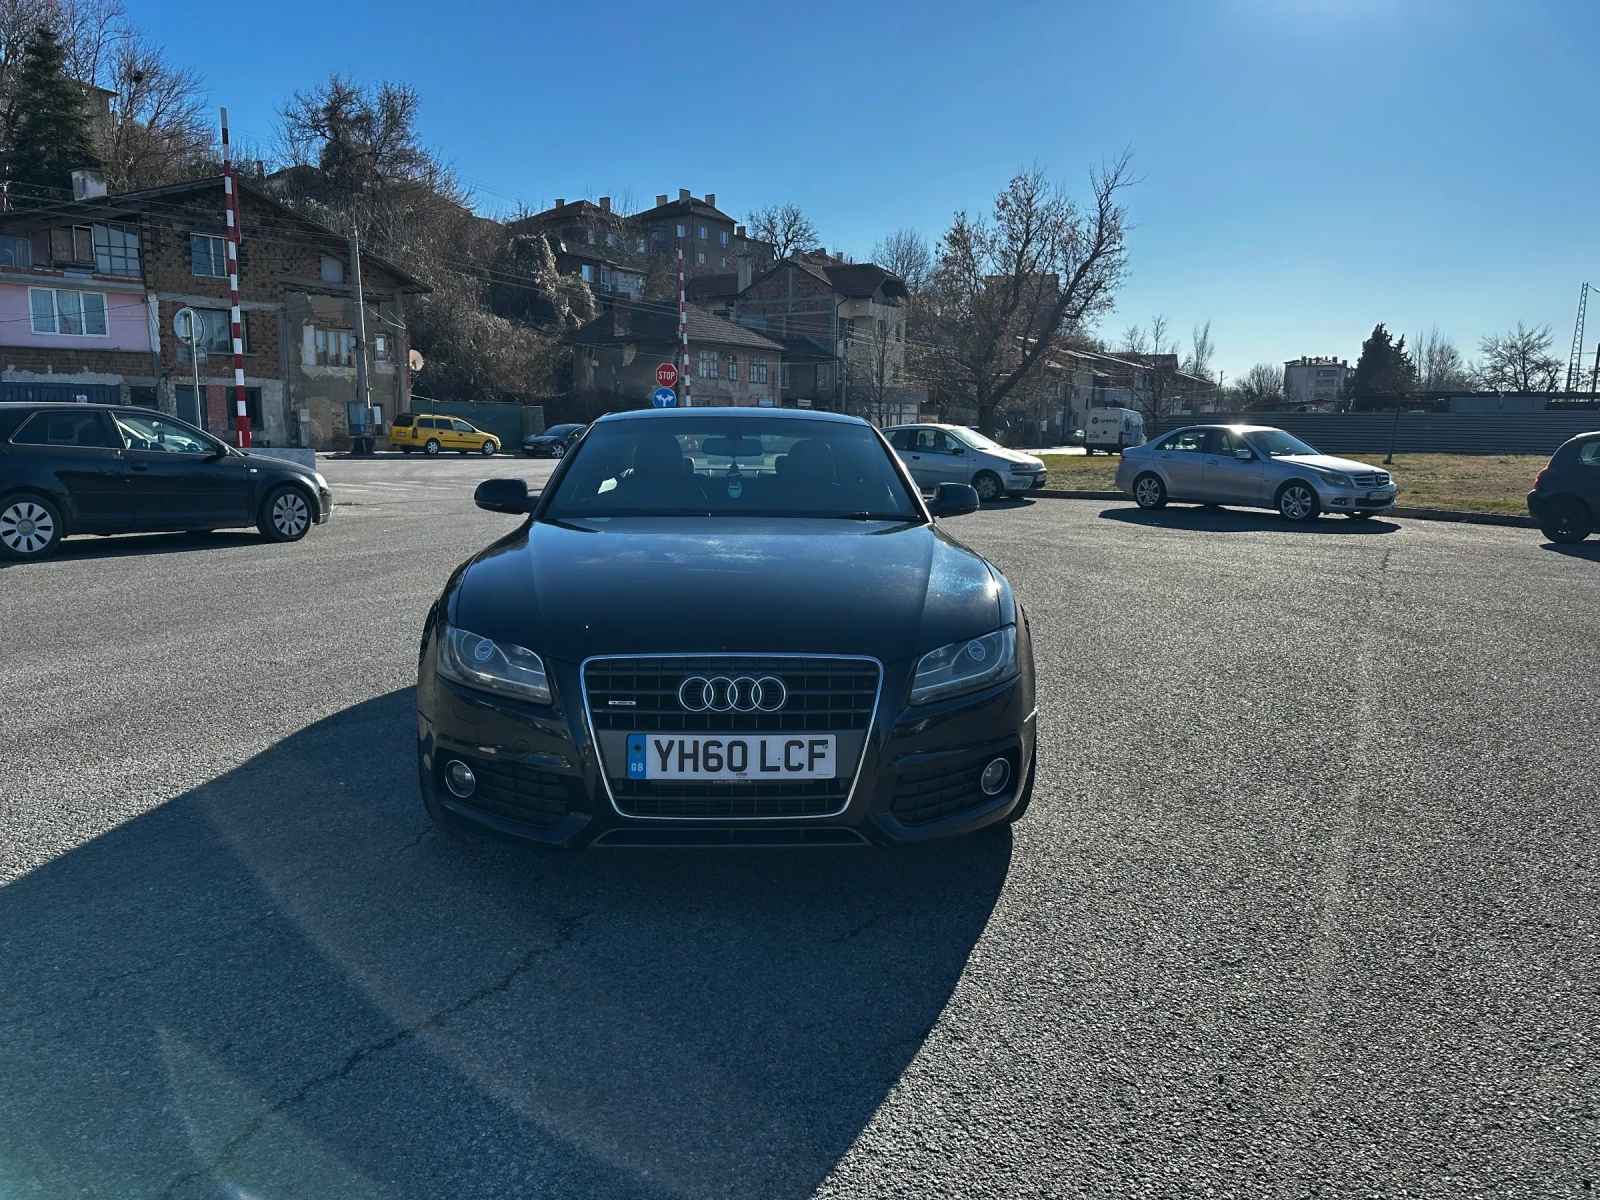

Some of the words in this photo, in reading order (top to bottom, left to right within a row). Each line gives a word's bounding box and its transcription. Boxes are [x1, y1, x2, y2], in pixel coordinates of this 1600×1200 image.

[658, 371, 675, 380] STOP
[654, 740, 748, 772] YH60
[760, 740, 829, 772] LCF
[631, 762, 644, 772] GB
